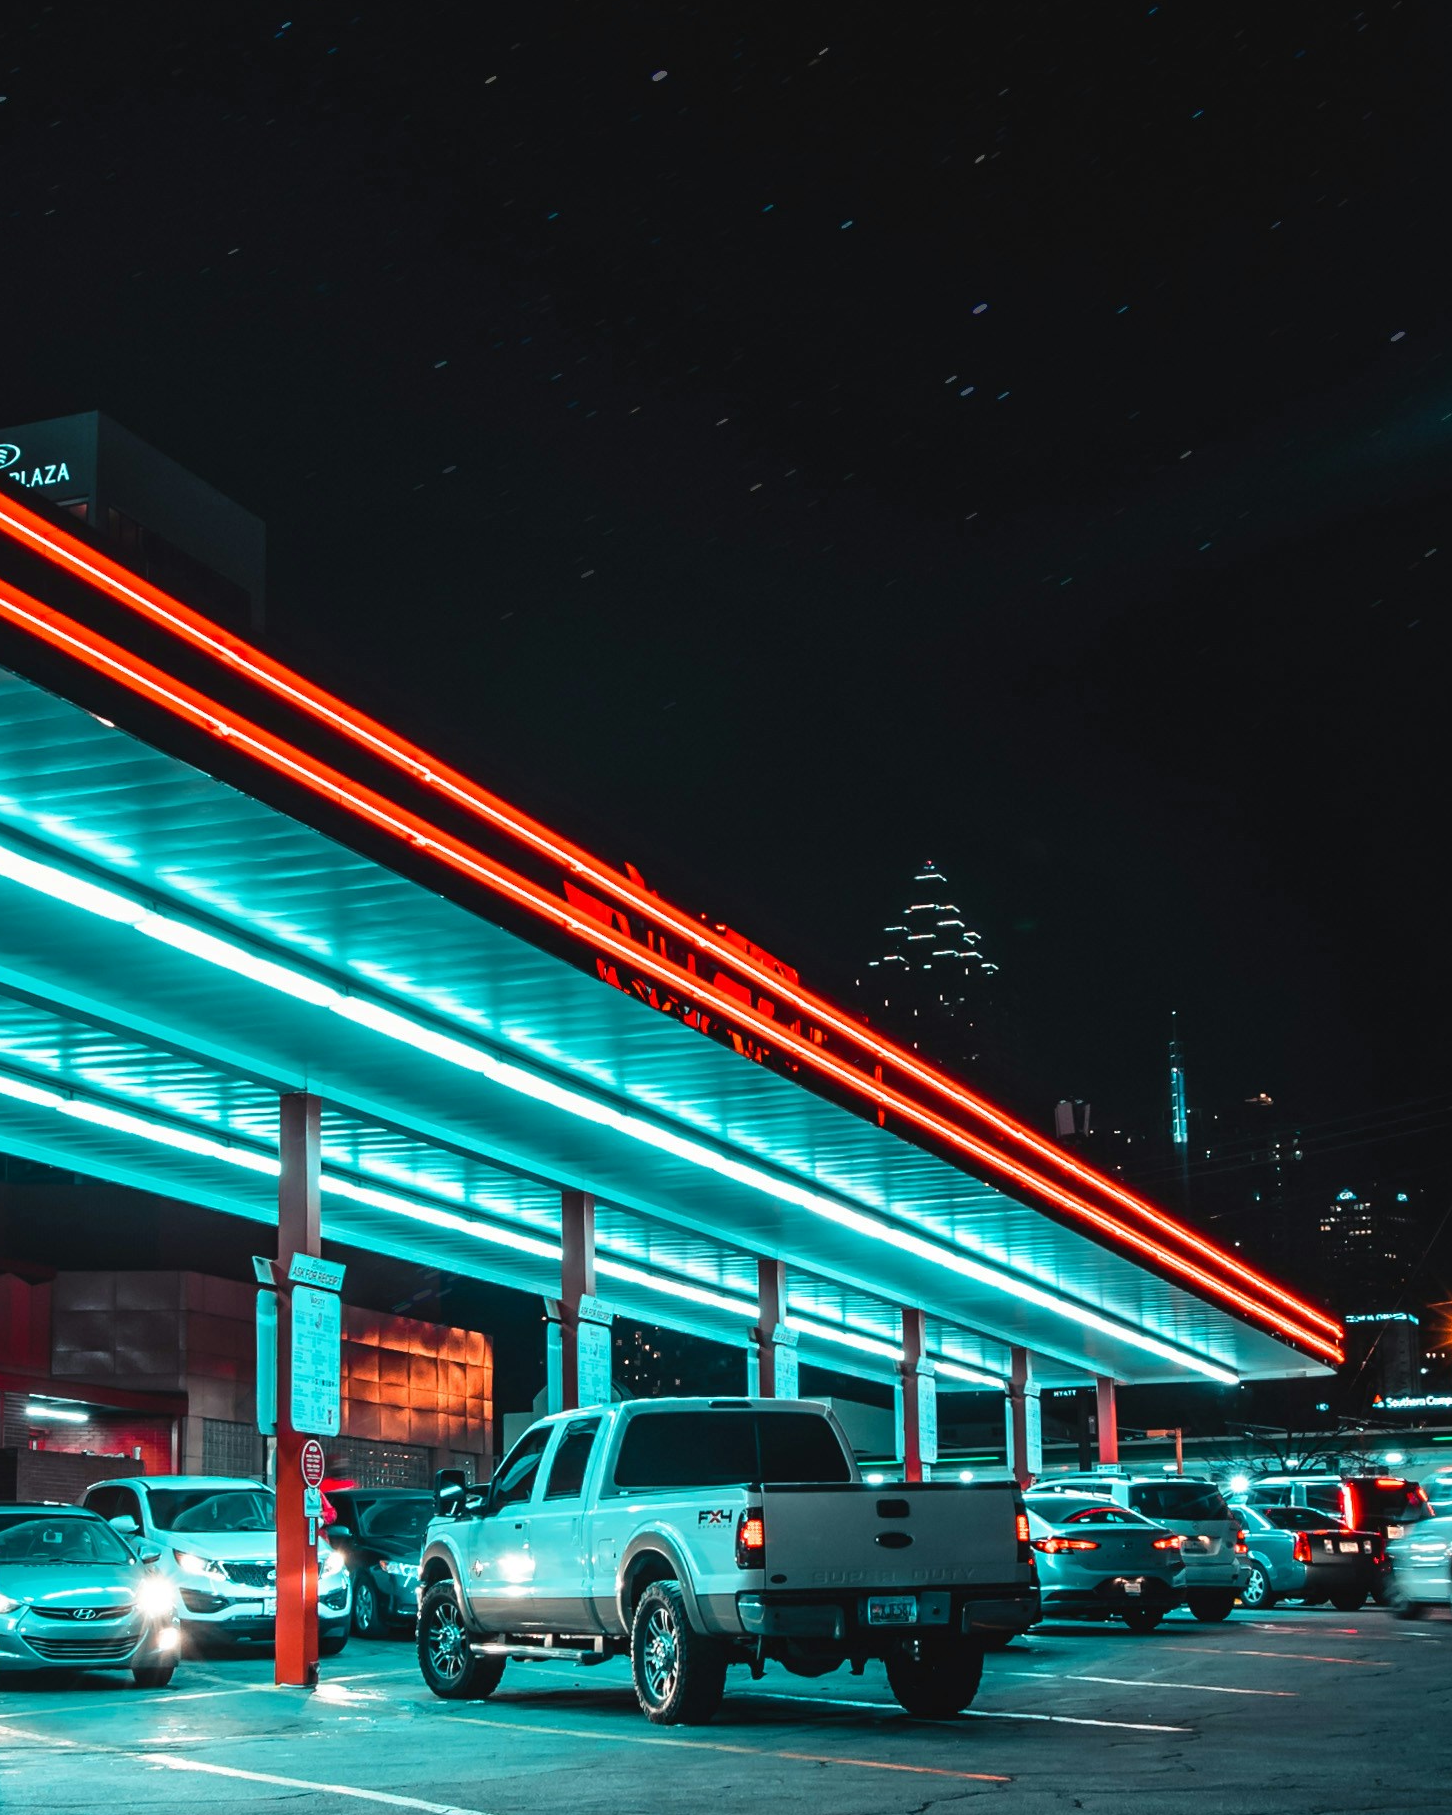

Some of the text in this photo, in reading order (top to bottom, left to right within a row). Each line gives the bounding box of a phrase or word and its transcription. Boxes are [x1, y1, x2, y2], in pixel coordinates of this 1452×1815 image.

[1053, 1389, 1076, 1397] HYATT
[1386, 1396, 1426, 1408] Southern
[698, 1509, 733, 1525] FX4
[911, 1568, 977, 1583] DUTY
